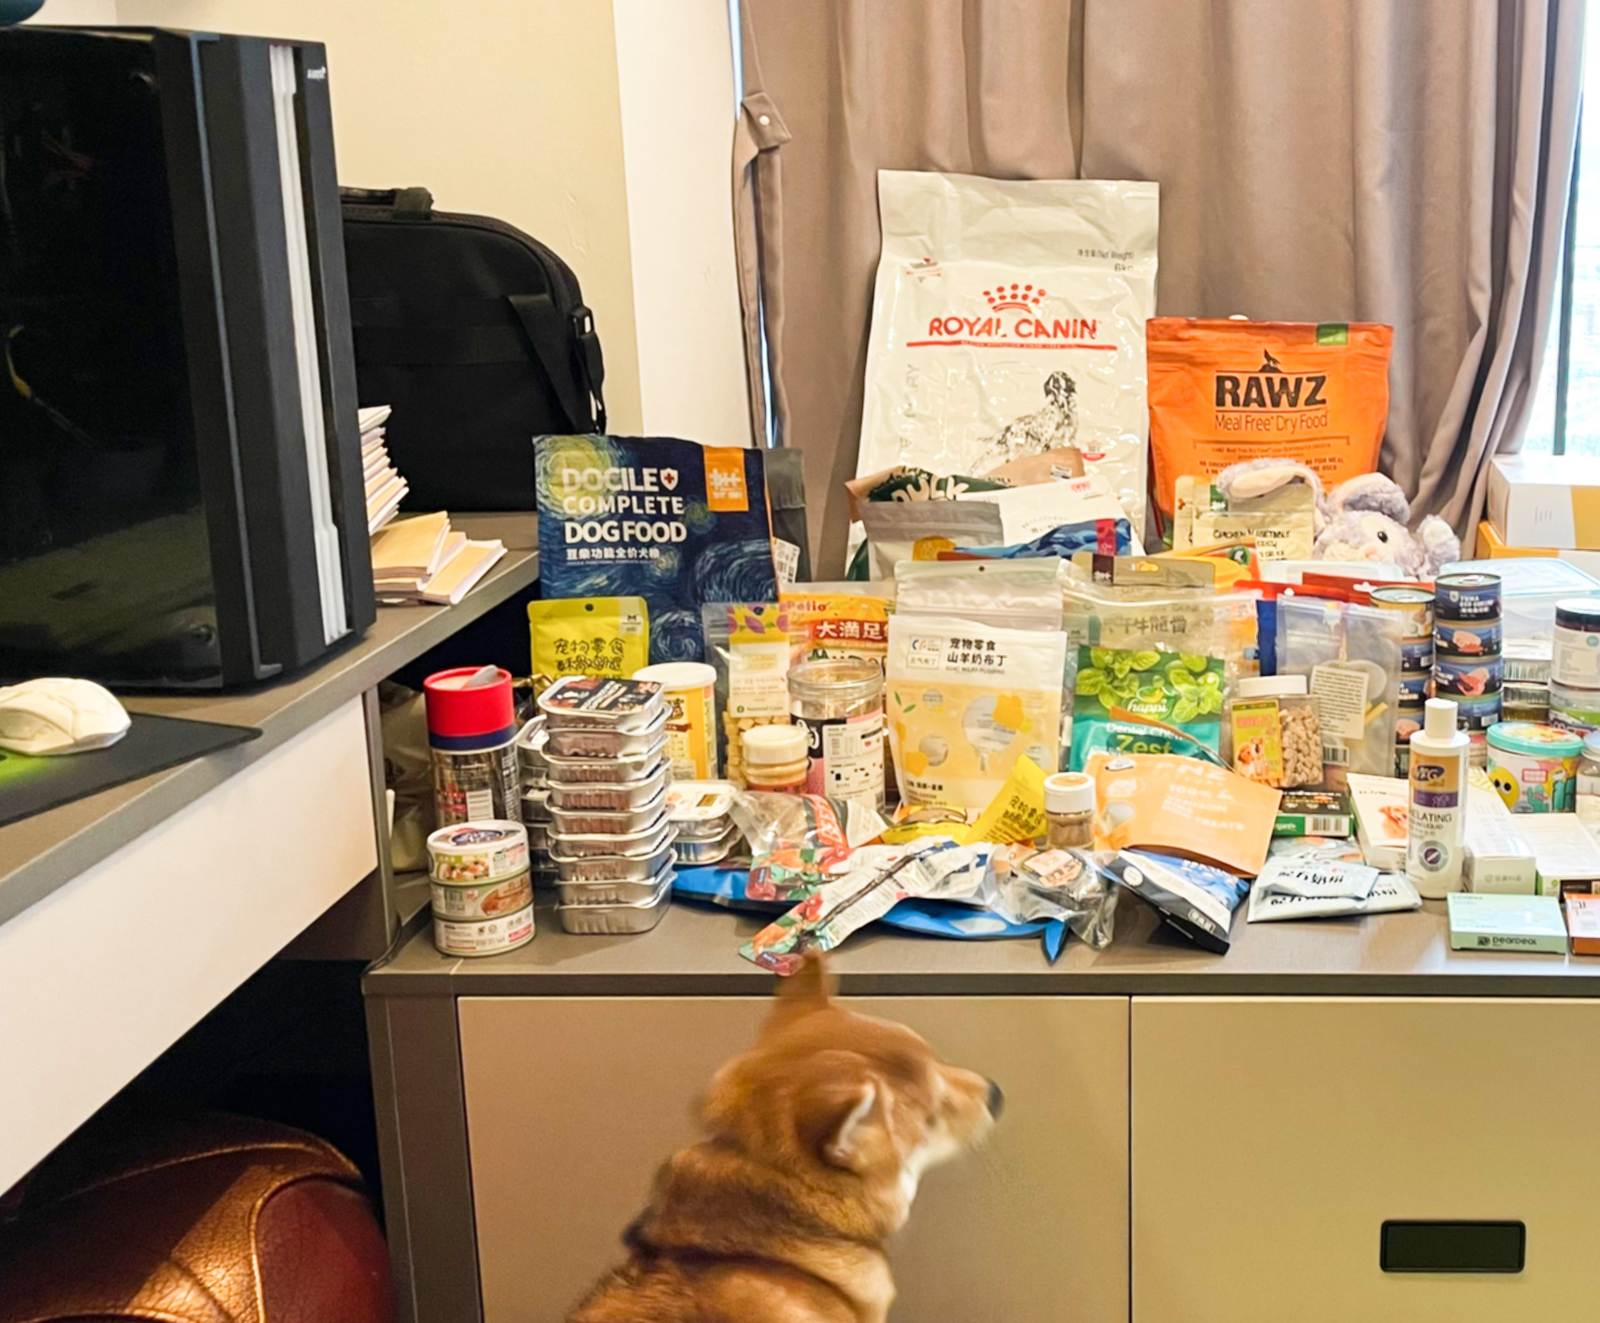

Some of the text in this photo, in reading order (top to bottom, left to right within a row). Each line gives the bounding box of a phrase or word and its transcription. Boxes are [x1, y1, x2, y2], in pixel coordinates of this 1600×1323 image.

[928, 317, 1097, 340] ROYAL CANIN
[1215, 375, 1327, 408] RAWZ
[1215, 414, 1243, 432] Meal
[1276, 413, 1298, 435] Dry
[1300, 411, 1328, 430] Food
[562, 468, 659, 493] DOCILE
[563, 496, 685, 515] COMPLETE
[815, 619, 888, 640] 大满足
[949, 637, 996, 652] 宠物零食
[947, 651, 1008, 667] 山羊奶布丁
[1116, 735, 1173, 754] Zest
